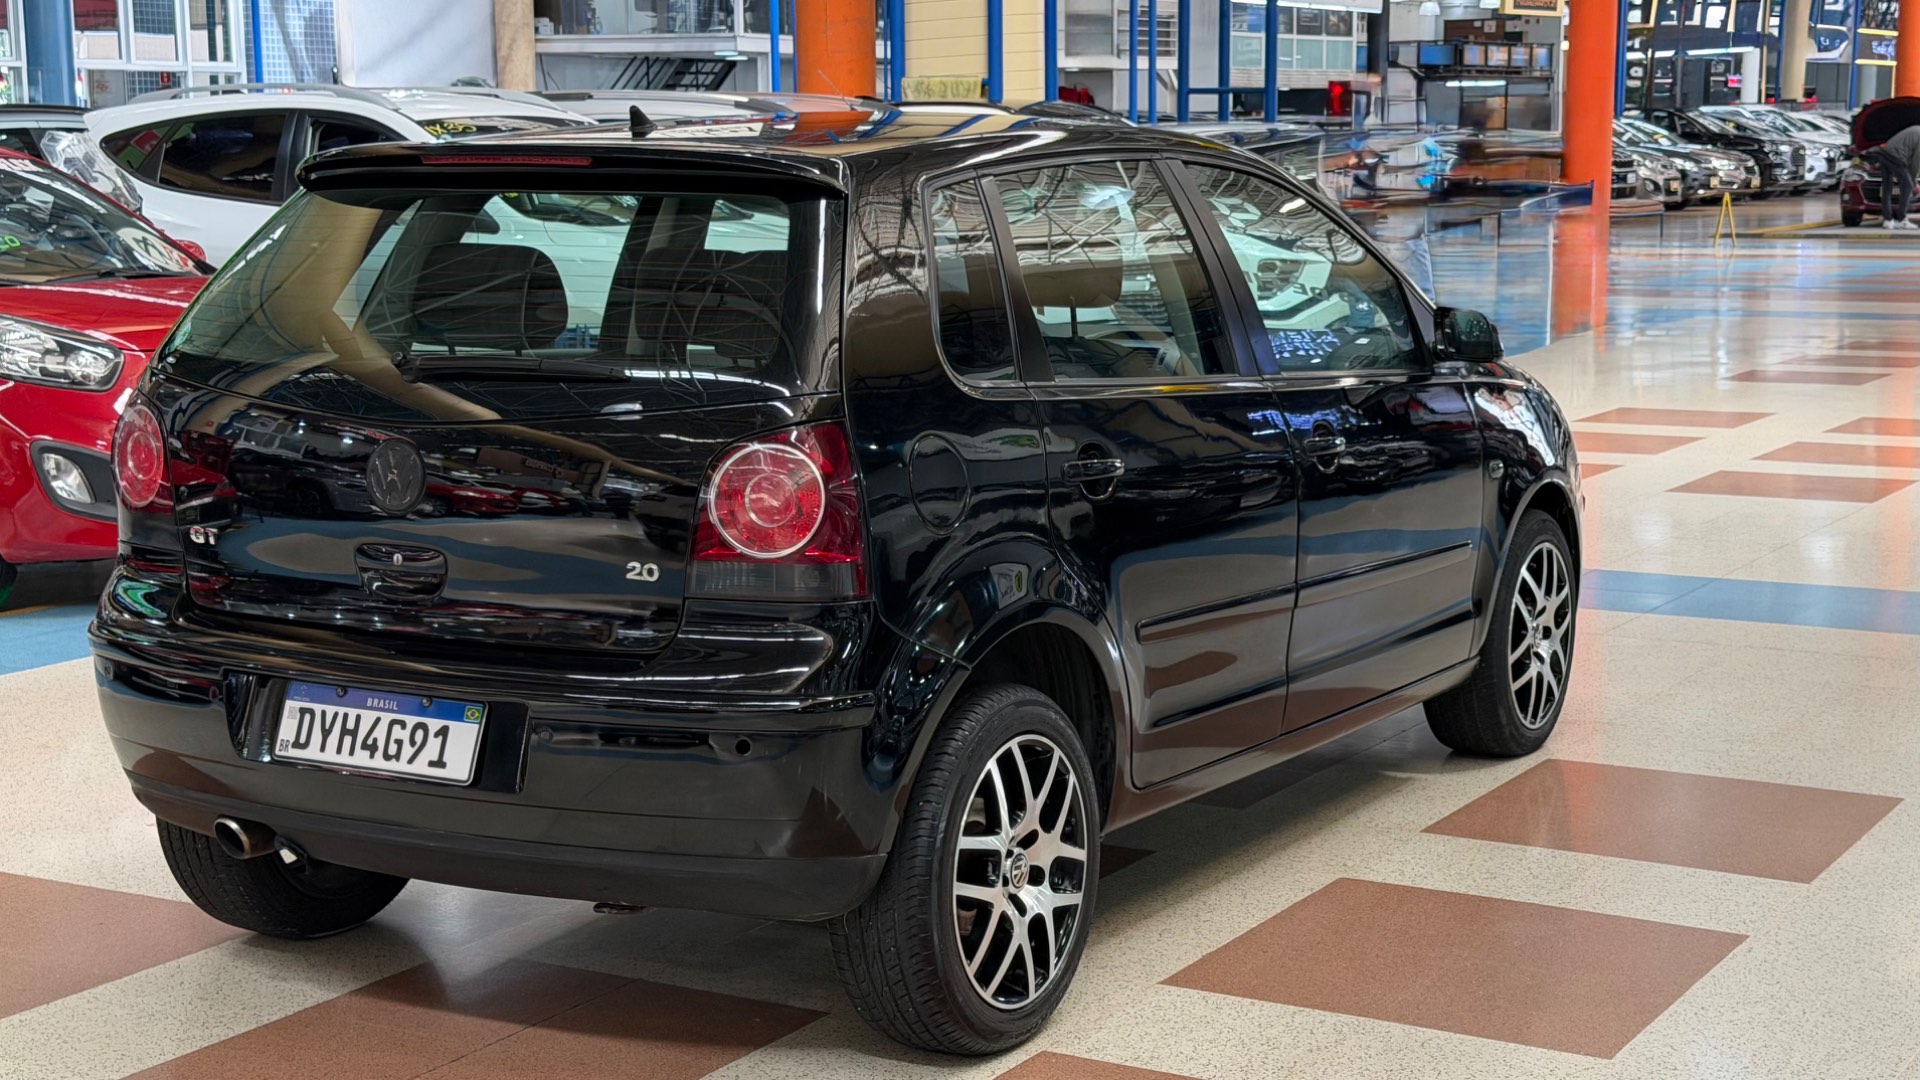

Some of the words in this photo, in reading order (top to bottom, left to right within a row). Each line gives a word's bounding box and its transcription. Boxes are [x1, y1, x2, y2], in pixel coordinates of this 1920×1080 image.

[190, 525, 218, 545] GT
[366, 697, 398, 711] BRASIL
[279, 738, 291, 753] BR
[291, 706, 450, 769] DYH4G91
